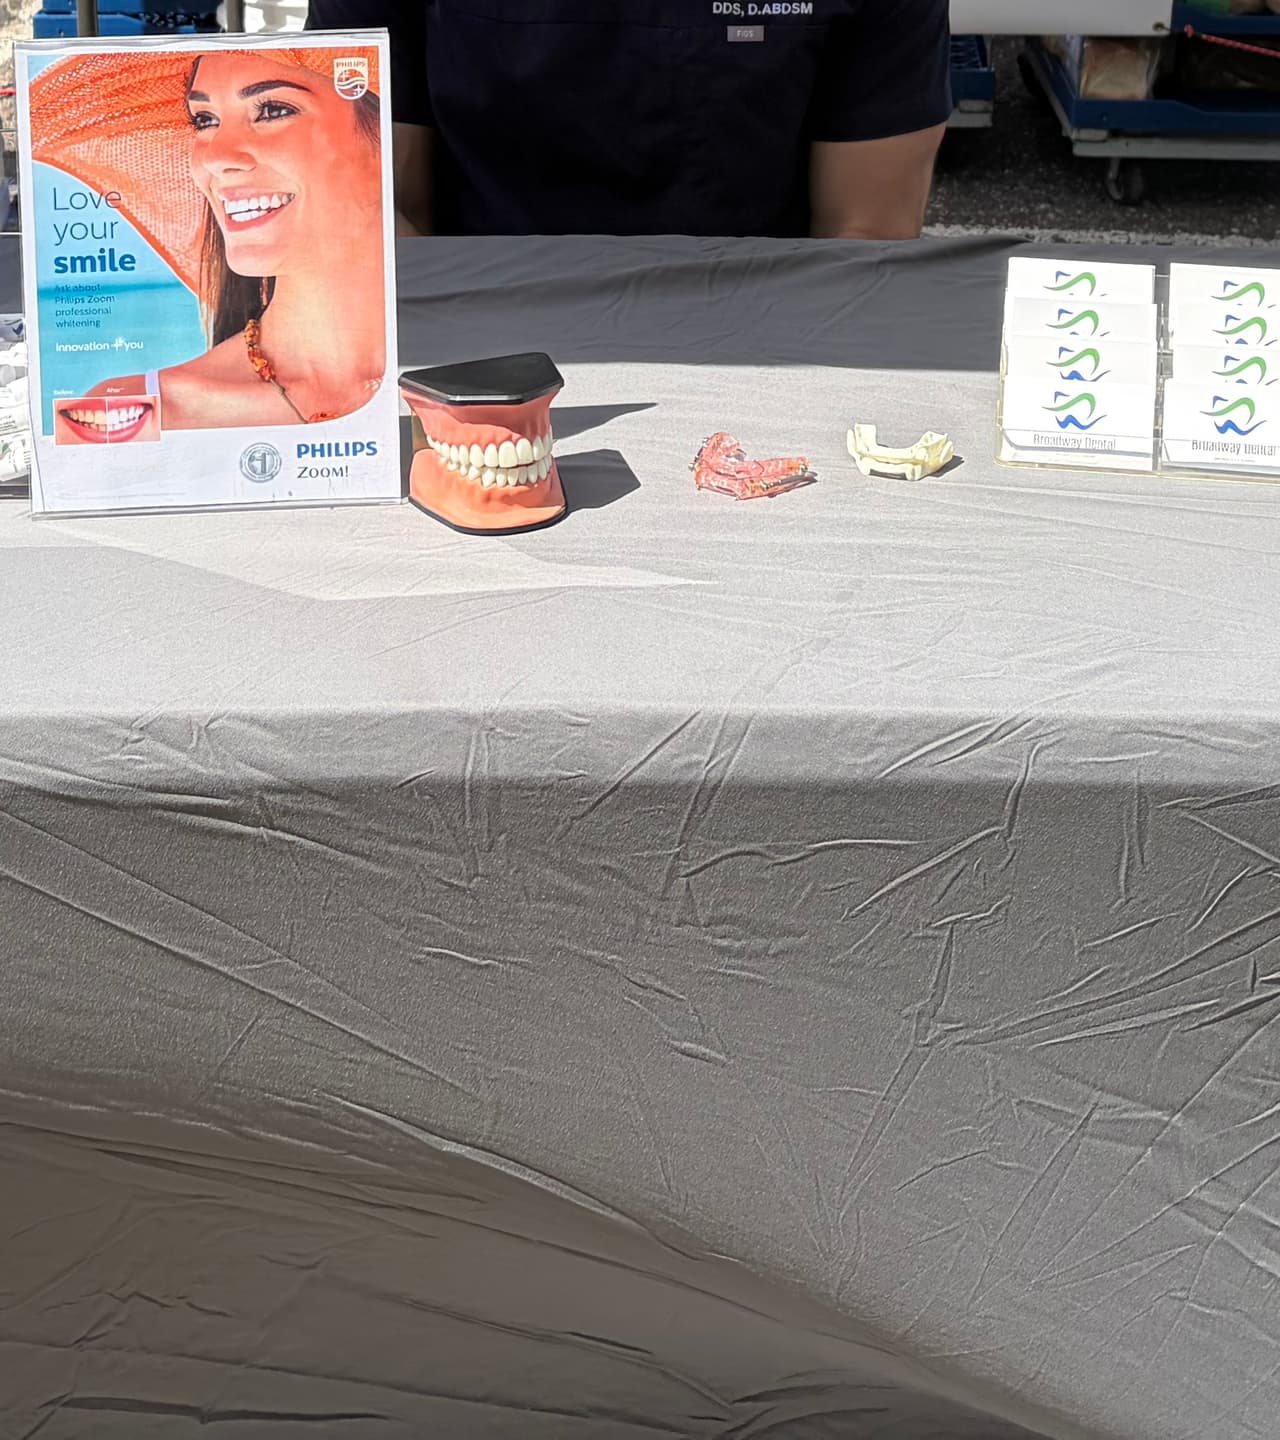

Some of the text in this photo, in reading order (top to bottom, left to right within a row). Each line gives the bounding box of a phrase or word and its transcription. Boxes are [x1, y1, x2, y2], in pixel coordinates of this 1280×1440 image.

[713, 2, 813, 17] DDS, D.ABDSM
[53, 186, 122, 211] Love
[53, 218, 119, 246] your
[54, 248, 136, 274] smile
[56, 307, 112, 317] professional
[56, 320, 100, 328] whitening
[297, 441, 378, 458] PHILIPS
[1034, 433, 1082, 450] Broadway
[297, 465, 348, 478] ZOOM!
